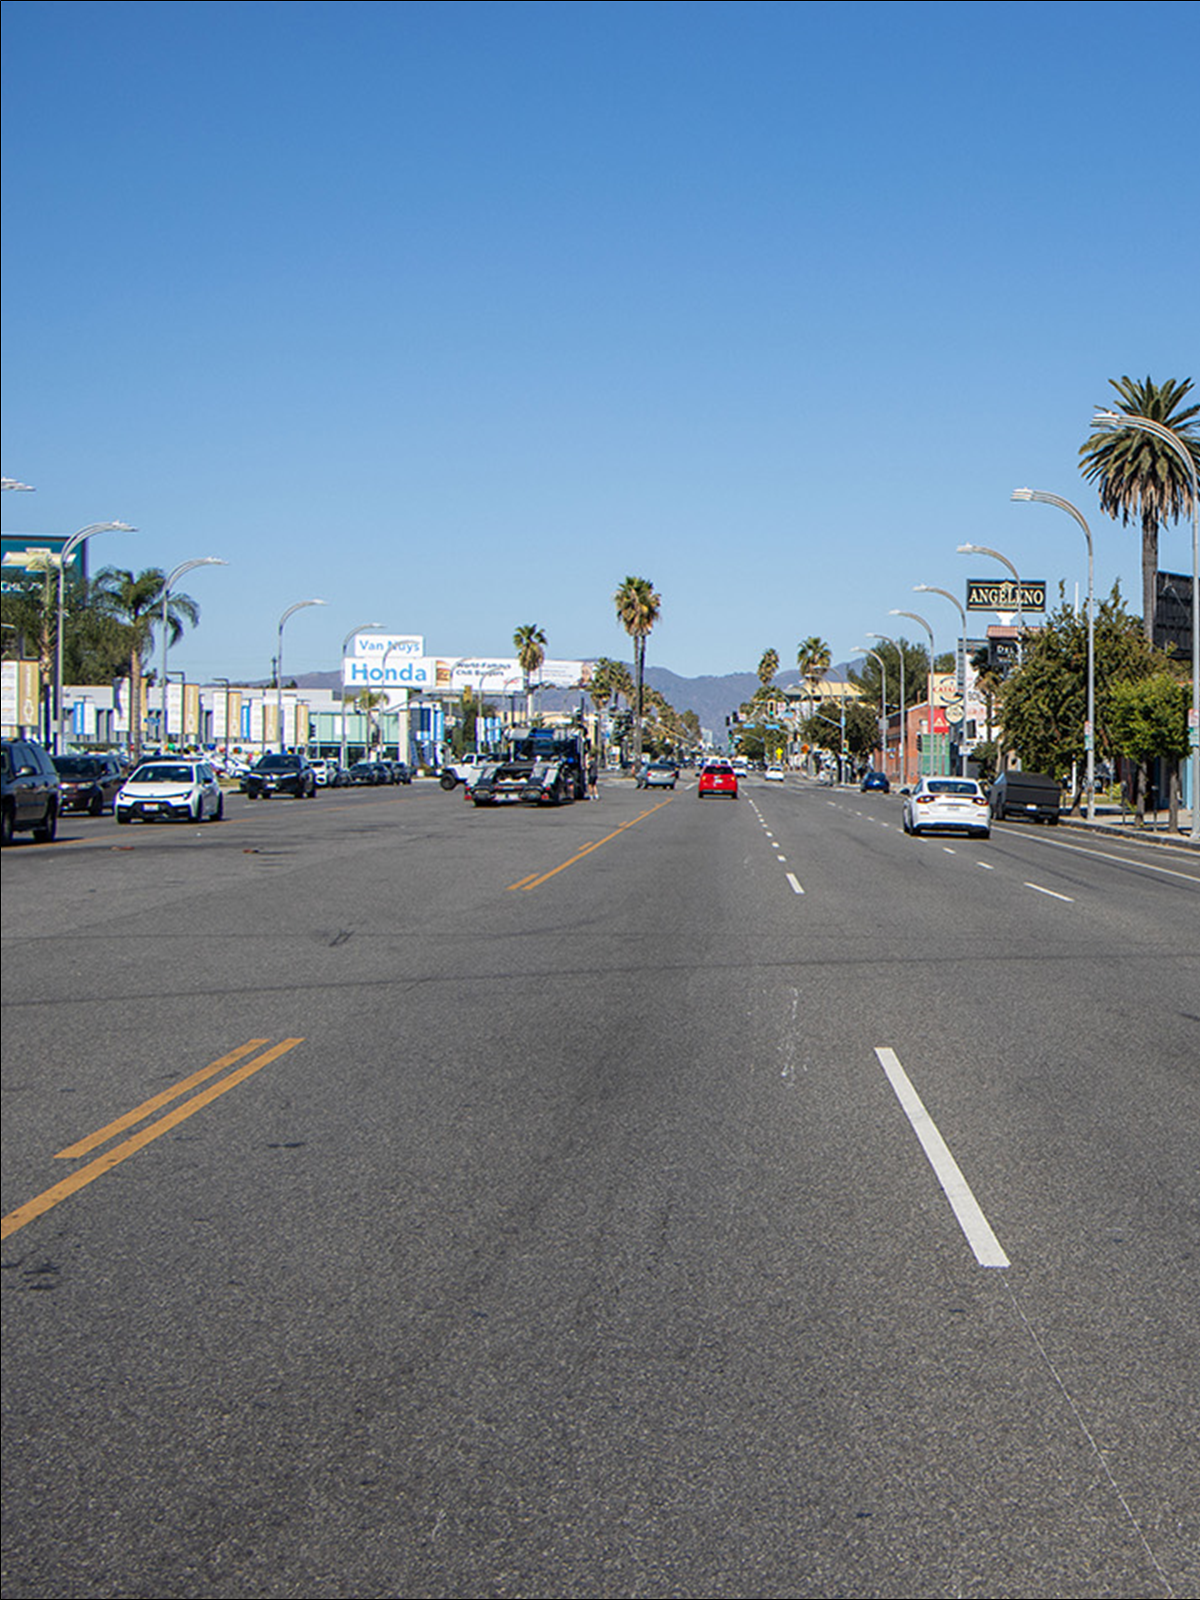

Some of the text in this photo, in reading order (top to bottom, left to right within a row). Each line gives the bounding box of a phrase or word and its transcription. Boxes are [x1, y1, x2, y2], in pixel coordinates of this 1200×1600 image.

[359, 640, 421, 653] Van Nuys
[351, 663, 427, 681] Honda
